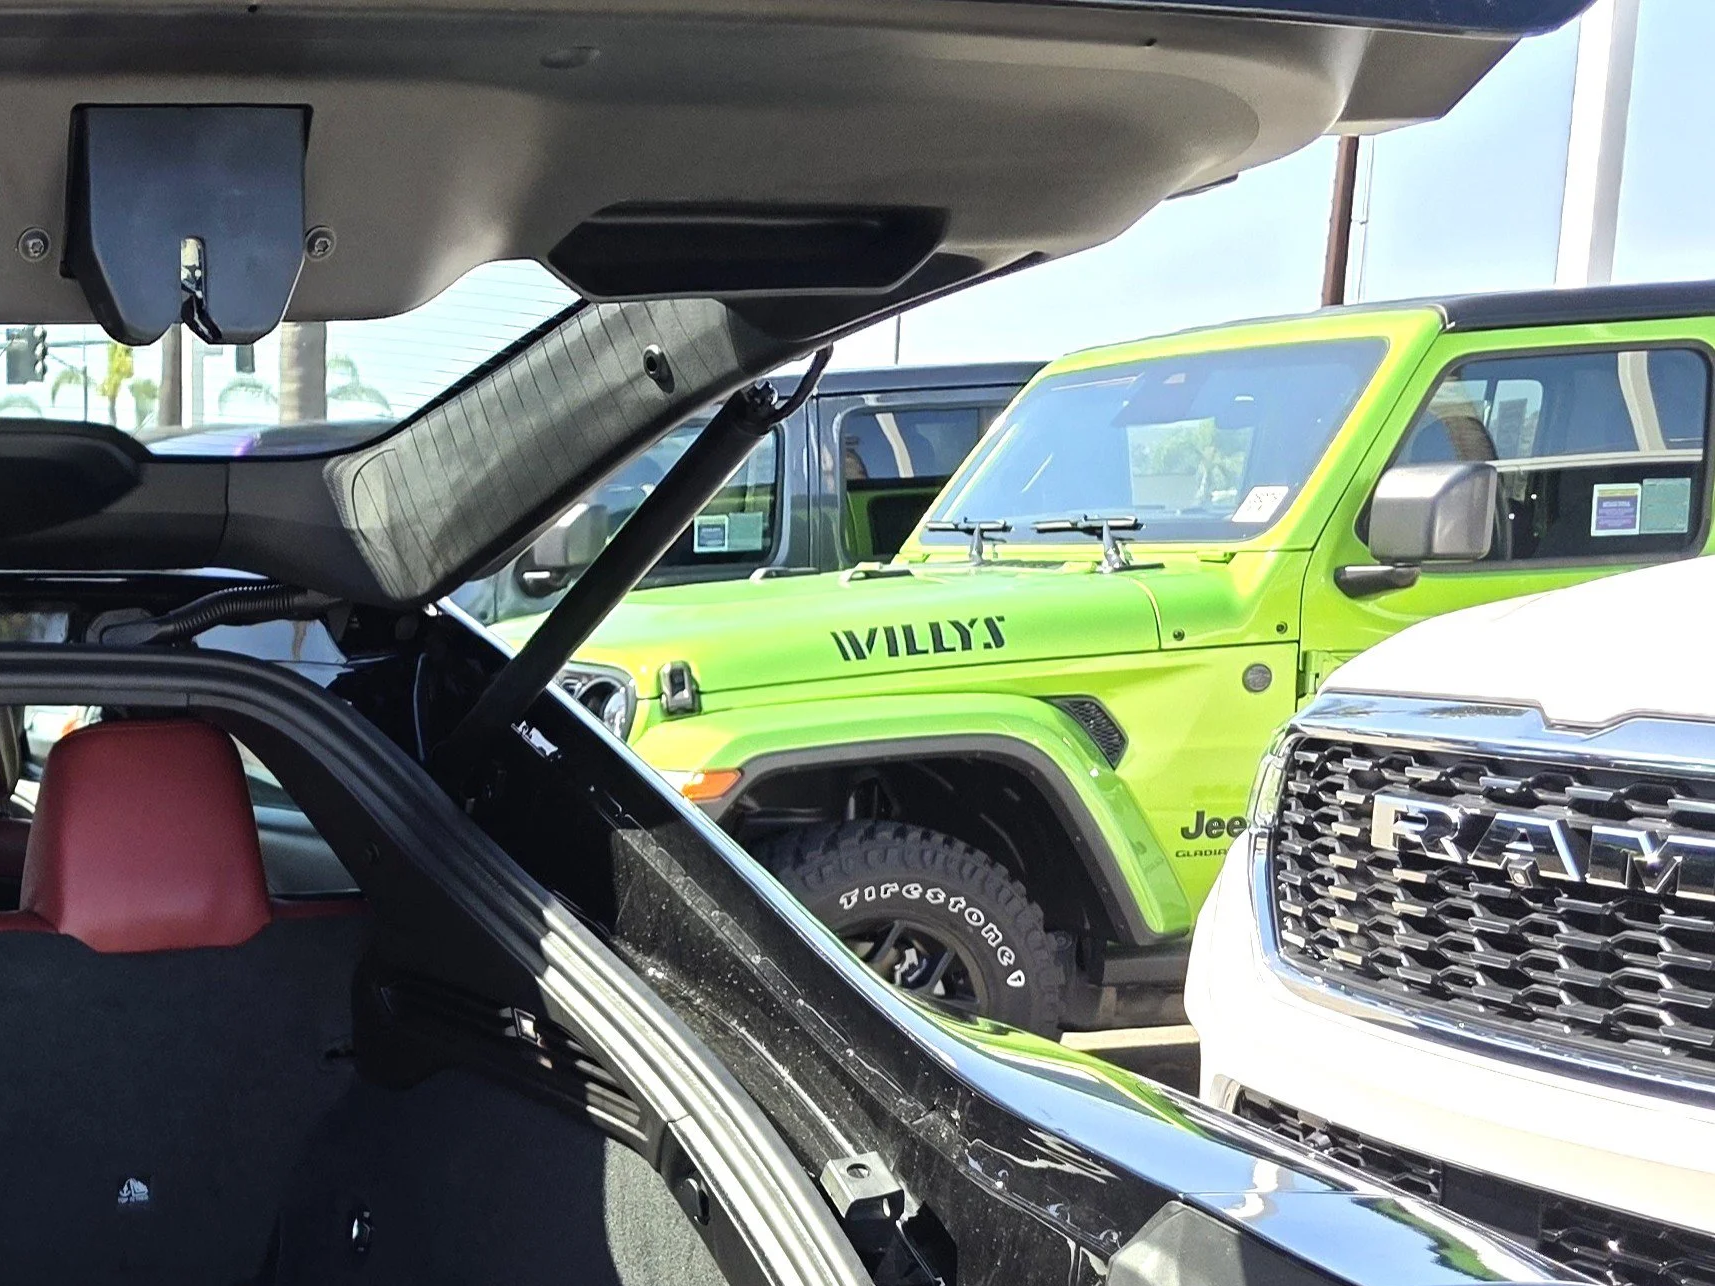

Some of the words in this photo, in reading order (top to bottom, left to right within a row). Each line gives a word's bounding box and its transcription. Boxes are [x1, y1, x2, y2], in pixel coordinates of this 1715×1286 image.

[830, 615, 1005, 661] WILLYS
[1180, 810, 1247, 840] Jee
[1370, 793, 1715, 902] RAM
[1175, 848, 1229, 858] GLADIA
[839, 882, 1016, 967] Firestone
